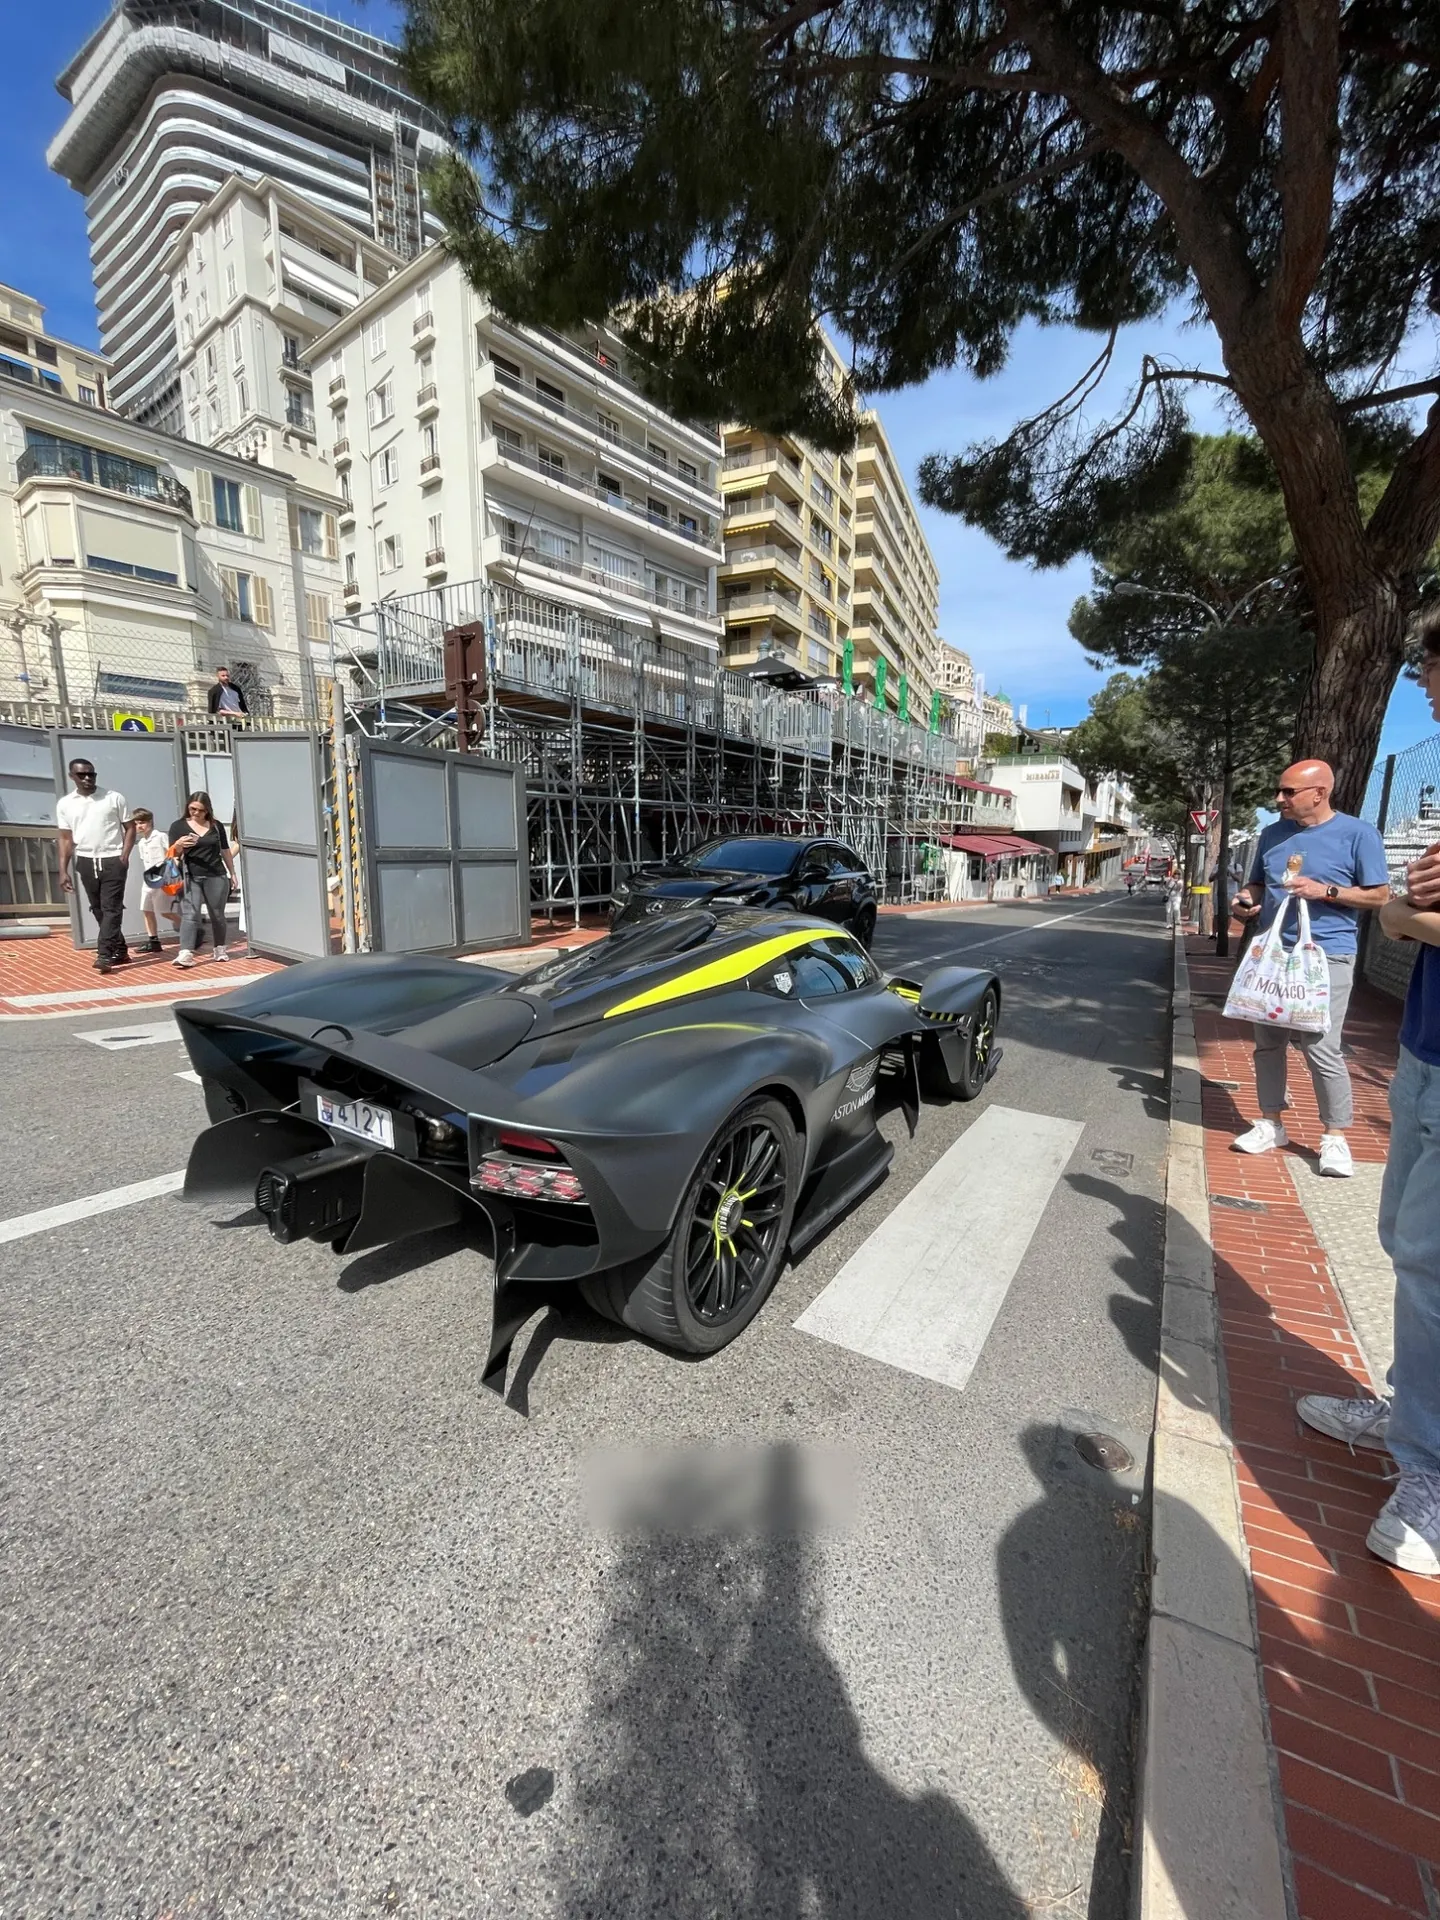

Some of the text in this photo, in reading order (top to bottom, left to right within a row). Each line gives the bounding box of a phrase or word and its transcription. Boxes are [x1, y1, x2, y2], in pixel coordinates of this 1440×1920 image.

[1254, 976, 1305, 1000] MONACO
[338, 1103, 384, 1137] 412Y
[831, 1099, 858, 1122] ASTON
